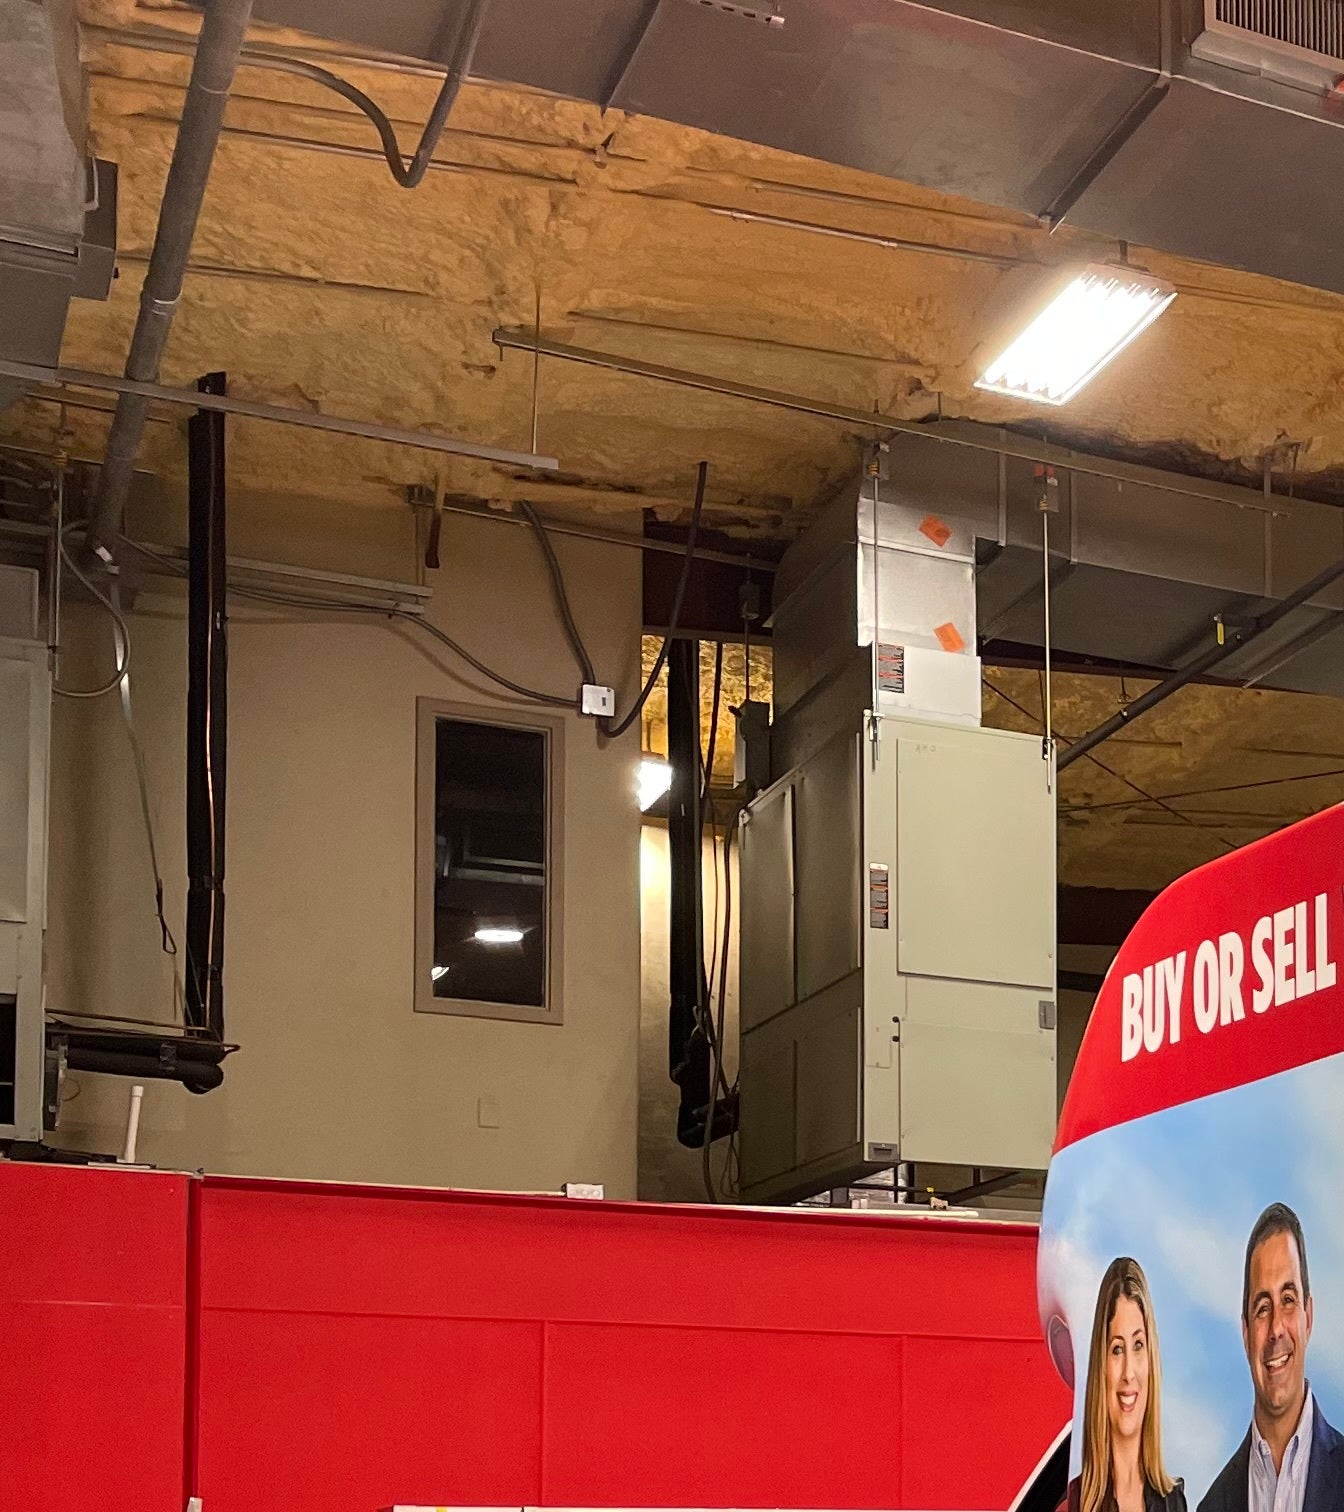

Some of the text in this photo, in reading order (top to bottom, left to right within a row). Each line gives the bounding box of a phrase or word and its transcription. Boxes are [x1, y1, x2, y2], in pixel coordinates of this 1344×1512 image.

[1122, 950, 1186, 1062] BUY
[1193, 930, 1245, 1034] OR
[1252, 892, 1336, 1013] SELL
